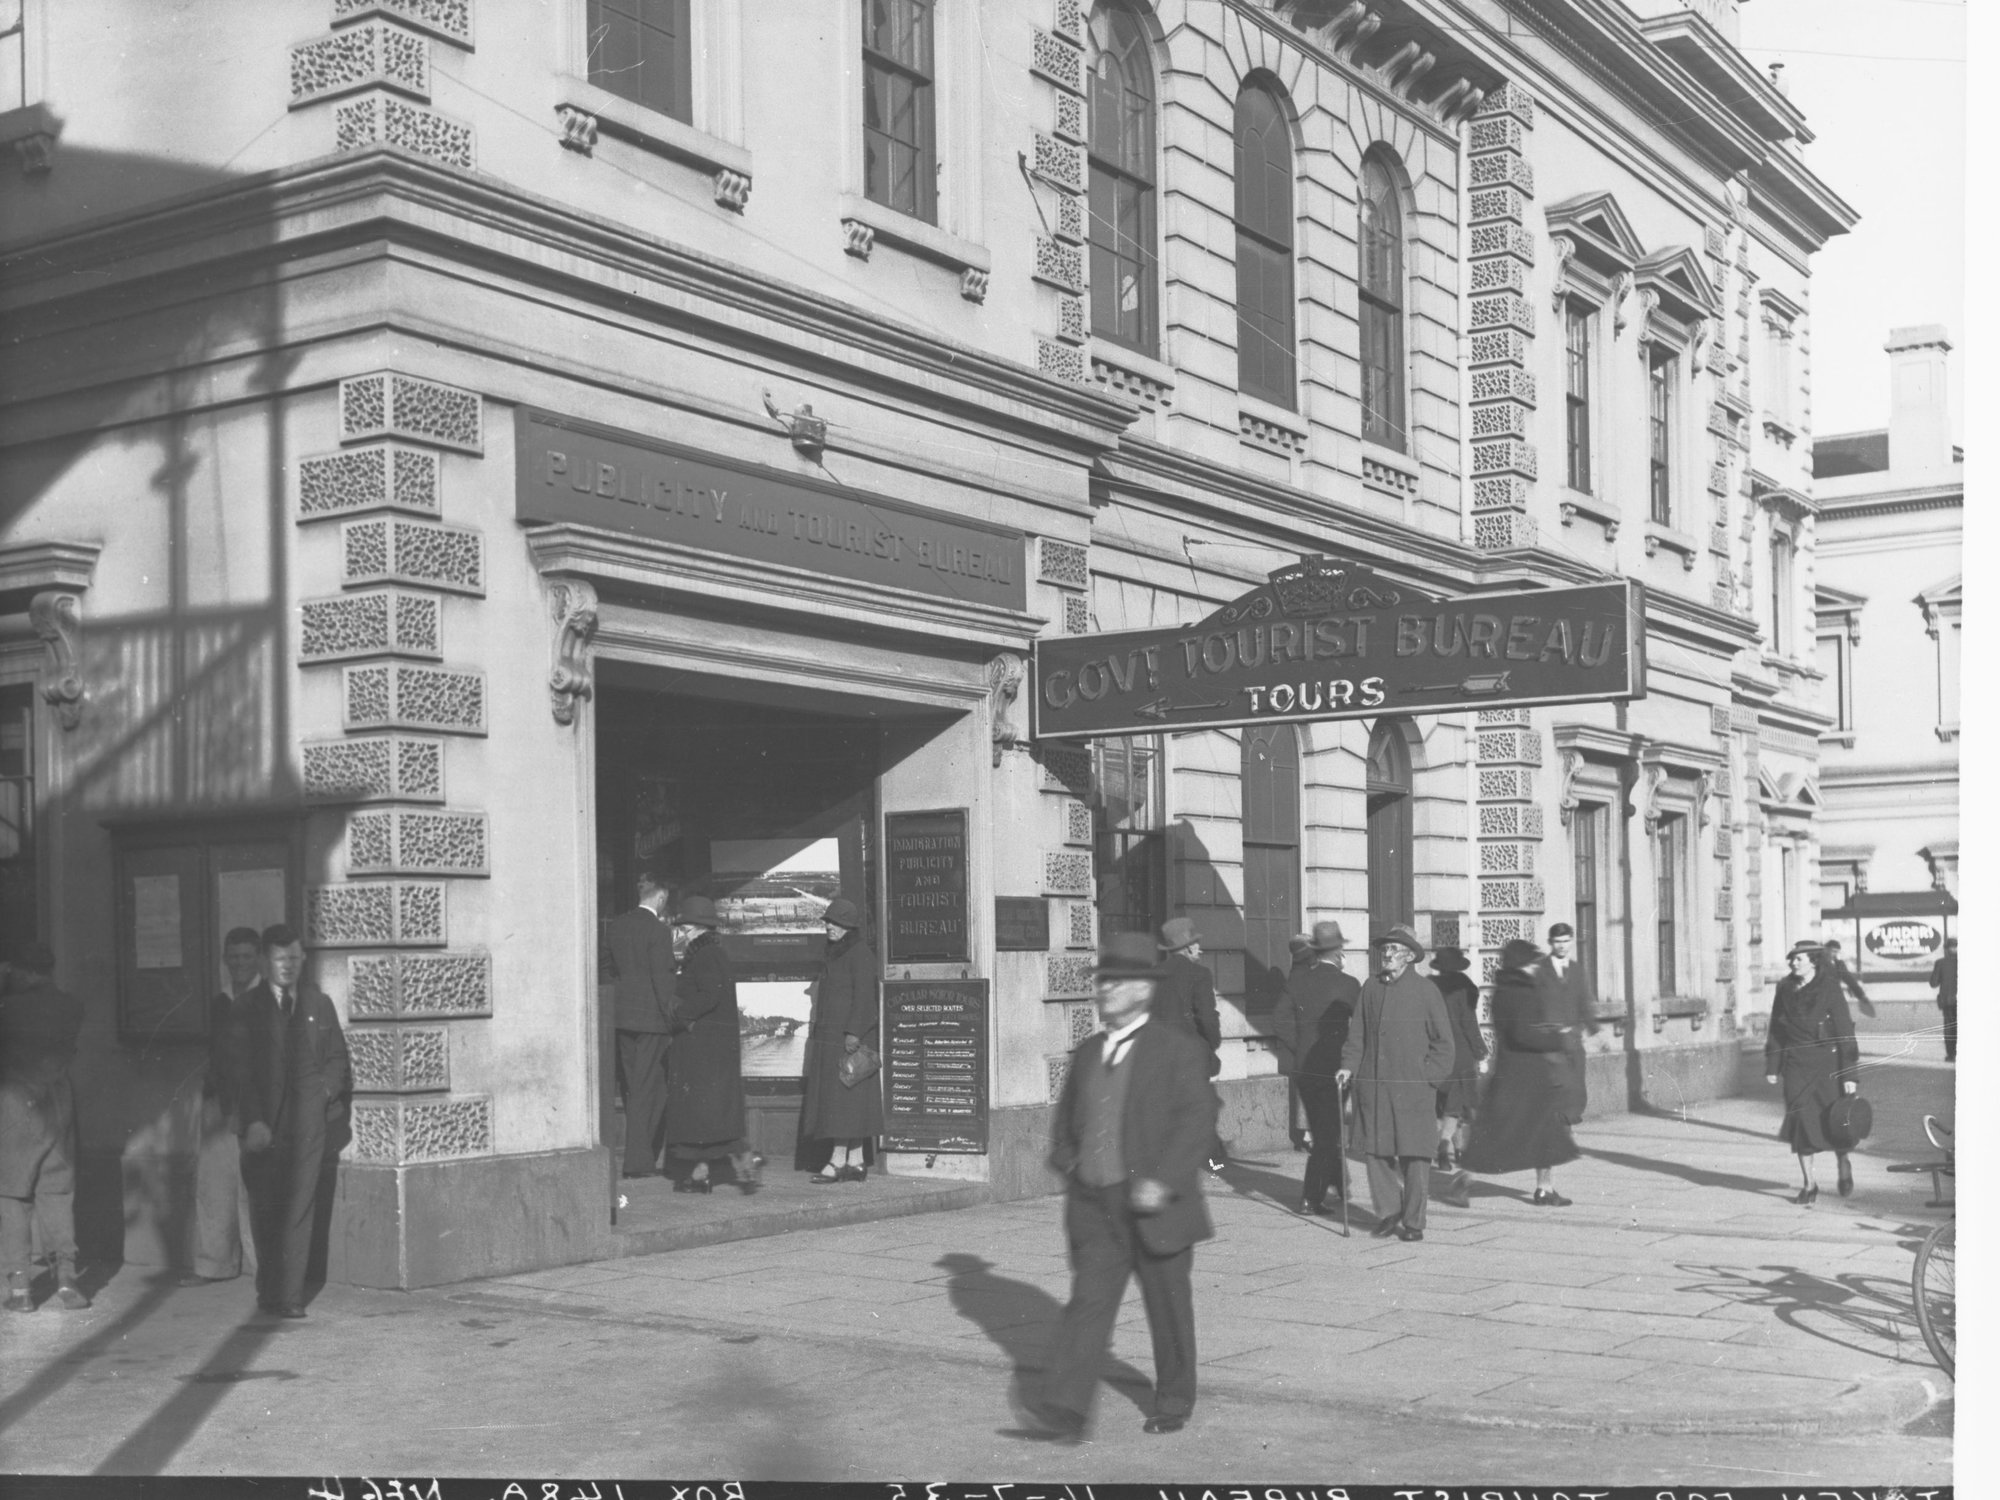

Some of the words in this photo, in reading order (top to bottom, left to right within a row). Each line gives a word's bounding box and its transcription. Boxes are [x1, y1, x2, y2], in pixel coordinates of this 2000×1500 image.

[545, 449, 728, 524] PUBLICITY
[738, 504, 779, 535] AND
[787, 510, 904, 562] TOURIST
[917, 535, 1013, 586] BUREAU
[1177, 614, 1377, 680] TOURIST
[1395, 613, 1616, 670] BUREAU
[1243, 675, 1386, 715] TOURS
[893, 836, 961, 852] IMMIGRATION
[899, 856, 954, 870] PUBLICITY
[915, 874, 941, 887] AND
[897, 891, 958, 908] TOURIST
[899, 919, 958, 936] BUREAU
[916, 1004, 942, 1012] SELECTED
[943, 1004, 964, 1012] ROUTES
